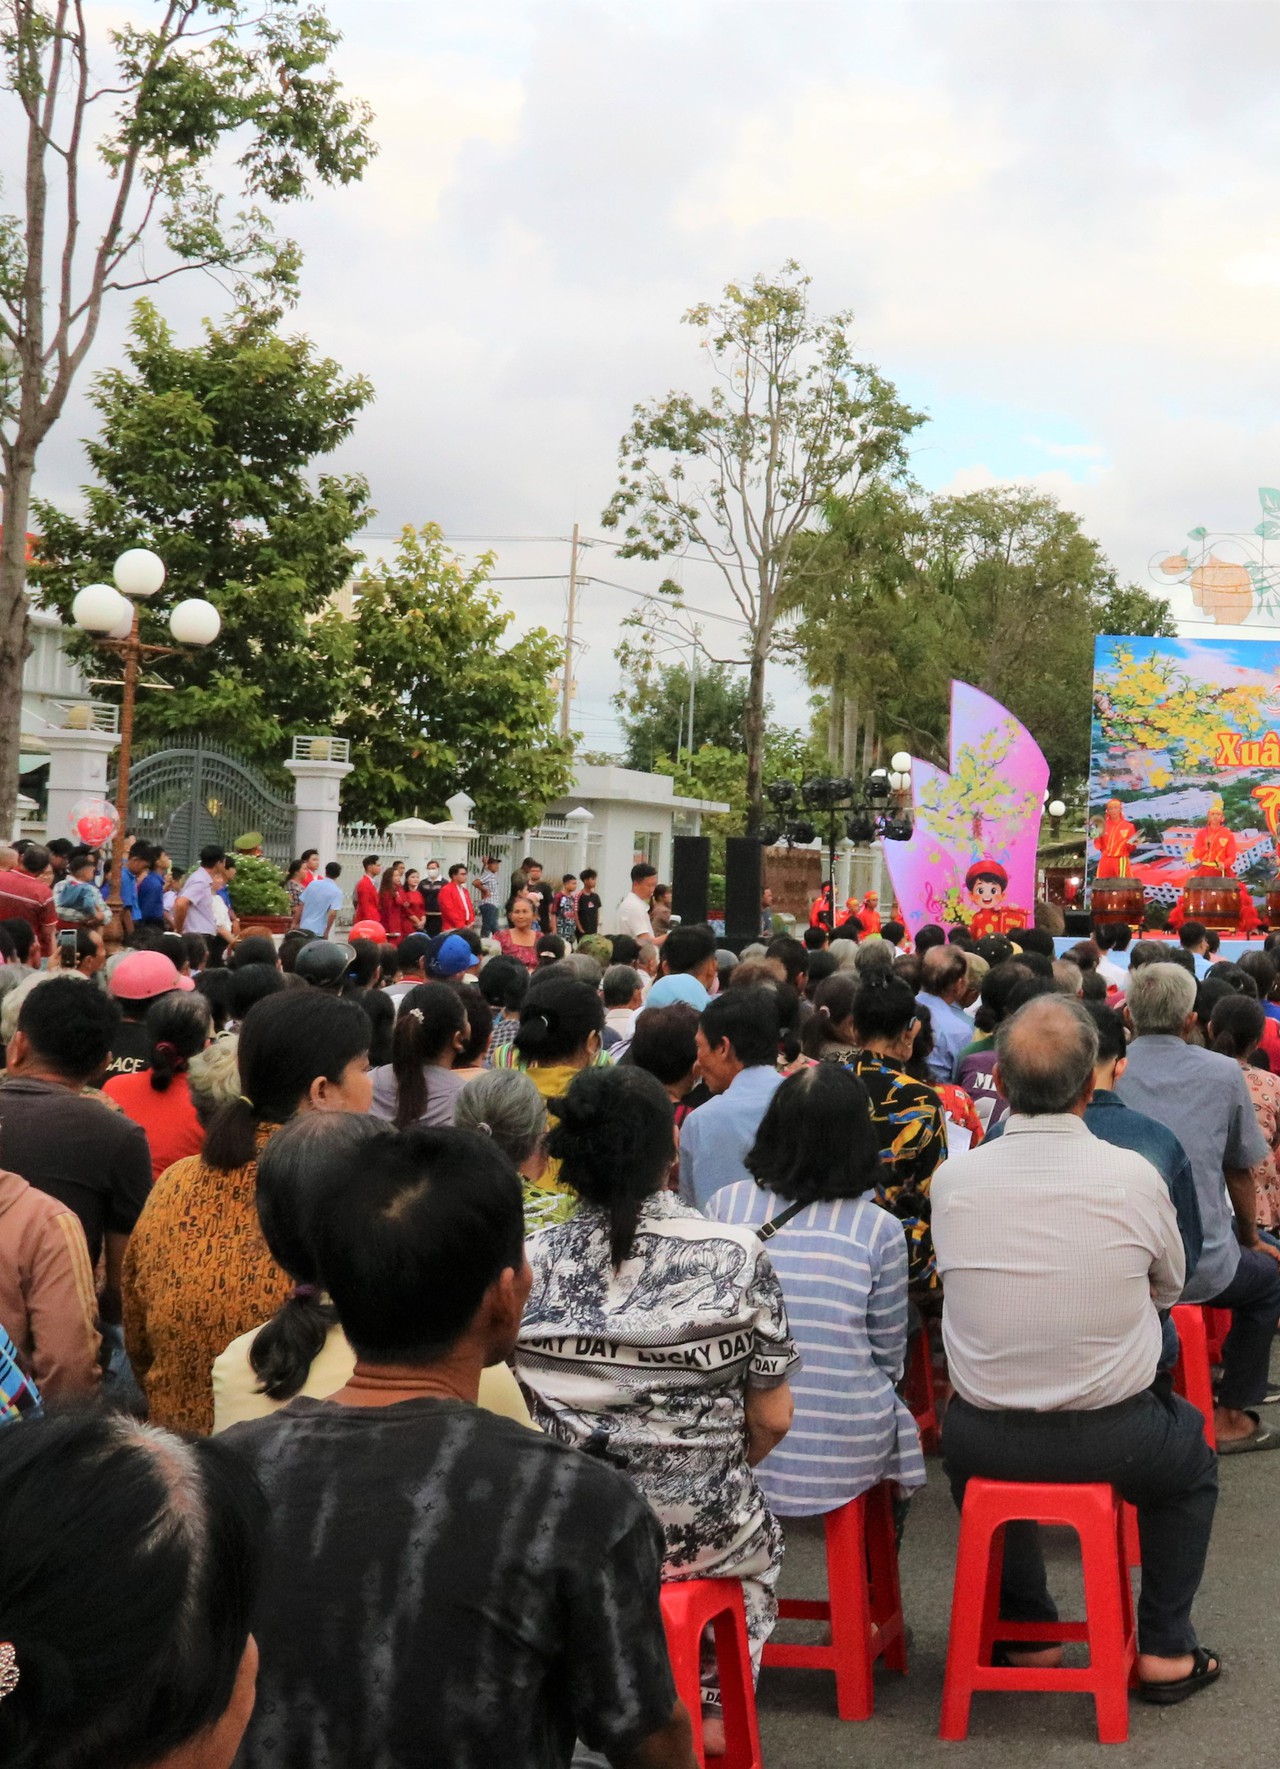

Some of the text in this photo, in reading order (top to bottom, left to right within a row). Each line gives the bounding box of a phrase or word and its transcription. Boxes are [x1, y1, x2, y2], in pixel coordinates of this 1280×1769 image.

[575, 1338, 621, 1359] DAY
[637, 1344, 713, 1368] LUCKY
[754, 1358, 779, 1373] DAY
